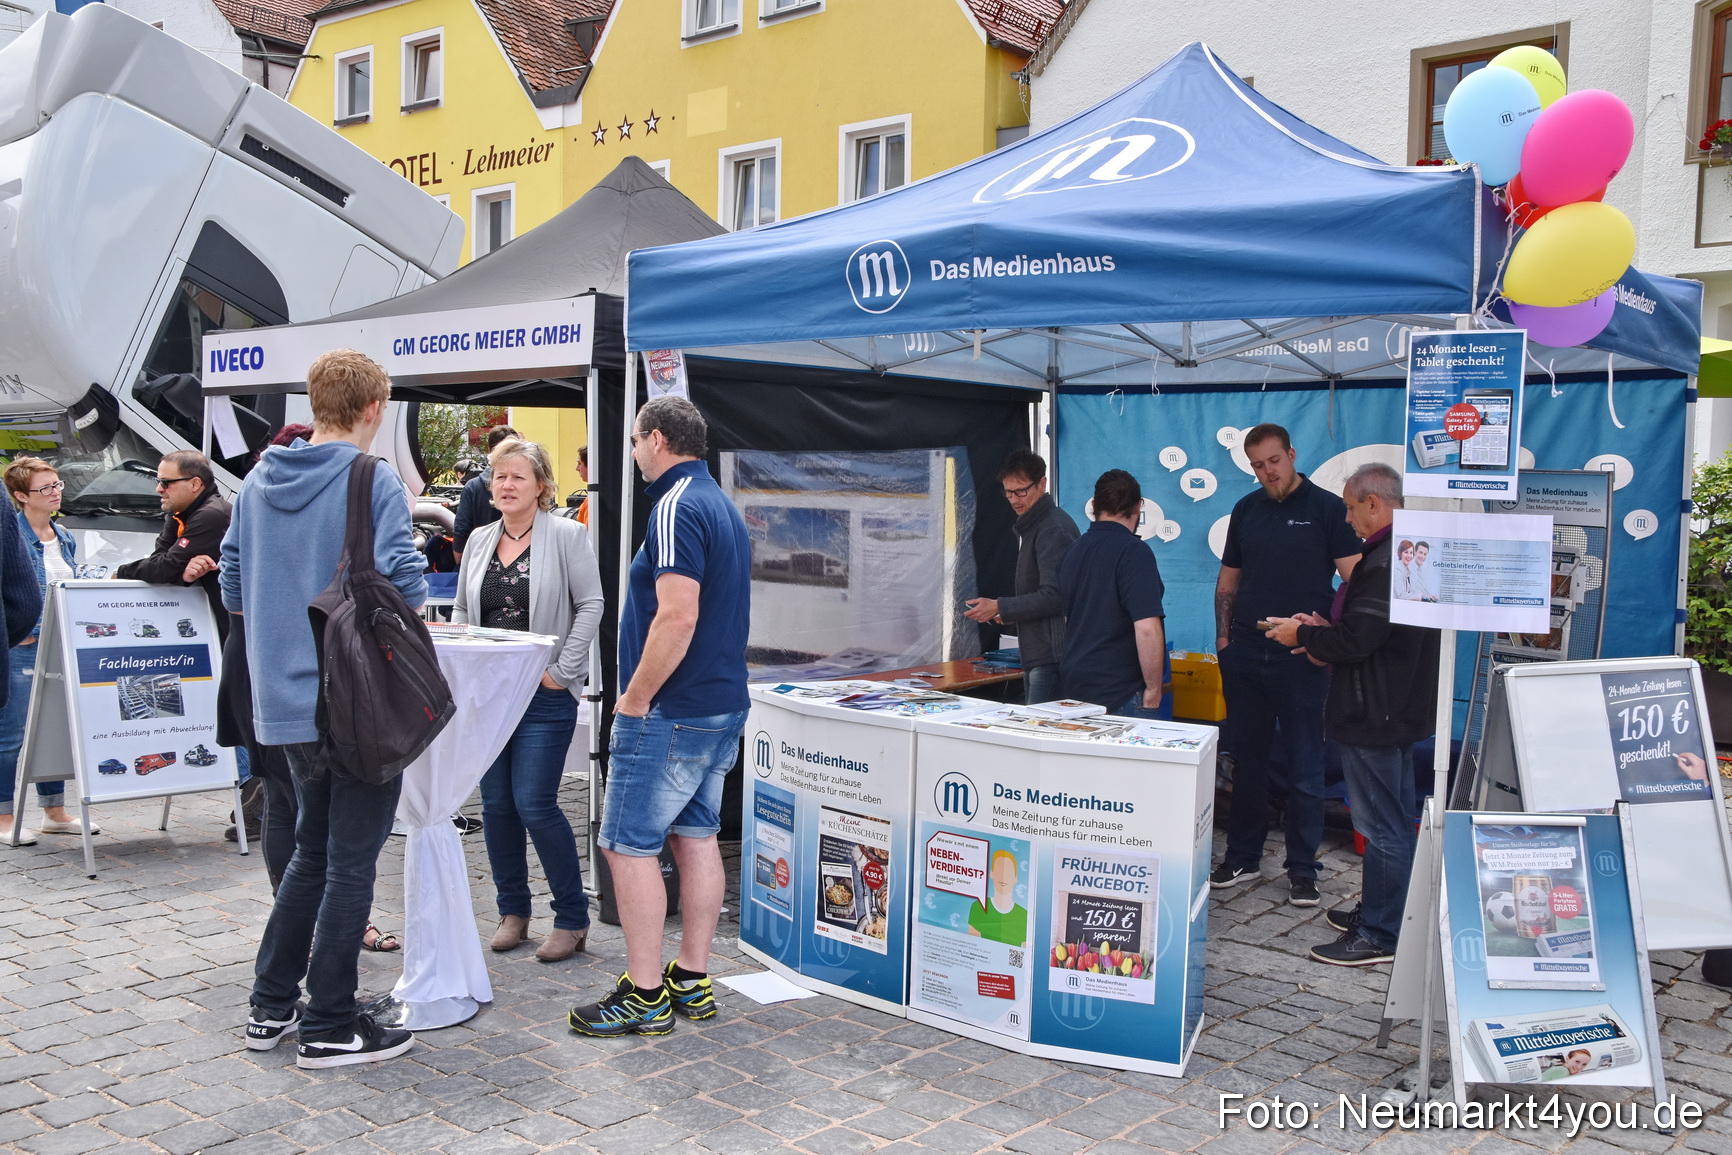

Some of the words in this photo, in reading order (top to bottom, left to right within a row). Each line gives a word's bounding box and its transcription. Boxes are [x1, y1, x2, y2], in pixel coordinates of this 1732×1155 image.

[382, 151, 442, 187] OTEL
[462, 137, 555, 176] Lehmeier
[930, 259, 970, 281] Das
[972, 253, 1116, 278] Medienhaus
[1618, 283, 1657, 315] Medienhaus
[393, 337, 416, 357] GM
[420, 333, 471, 355] GEORG
[475, 328, 527, 350] MEIER
[531, 323, 582, 346] GMBH
[1416, 346, 1427, 355] 24
[1429, 344, 1467, 354] Monate
[1469, 343, 1497, 353] lesen
[210, 346, 264, 373] IVECO
[1415, 357, 1444, 367] Tablet
[1446, 356, 1505, 369] geschenkt!
[1448, 423, 1475, 432] gratis
[1526, 487, 1540, 495] Das
[1542, 488, 1588, 497] Medienhaus
[1433, 561, 1485, 570] Gebietsleiter/in
[99, 654, 195, 671] Fachlagerist/in
[1642, 680, 1665, 693] Zeitung
[1666, 679, 1682, 689] lesen
[1618, 704, 1664, 741] 150
[1671, 700, 1690, 734] €
[92, 732, 108, 740] eine
[111, 729, 150, 739] Ausbildung
[781, 741, 796, 758] Das
[797, 747, 869, 774] Medienhaus
[1620, 740, 1671, 769] geschenkt!
[781, 761, 795, 774] Meine
[795, 766, 818, 782] Zeitung
[819, 773, 830, 784] für
[831, 775, 862, 789] zuhause
[780, 772, 789, 783] Das
[789, 774, 826, 794] Medienhaus
[827, 784, 838, 796] für
[839, 789, 857, 800] mein
[859, 792, 882, 805] Leben
[1635, 782, 1702, 794] Mittelbayerische
[993, 783, 1022, 801] Das
[1026, 788, 1134, 814] Medienhaus
[757, 803, 791, 826] Lesegutschein
[839, 815, 861, 826] Meine
[992, 806, 1020, 818] Meine
[1022, 810, 1059, 826] Zeitung
[1061, 815, 1076, 827] für
[1079, 817, 1123, 831] zuhause
[828, 821, 889, 843] KÜCHENSCHÄTZE
[992, 819, 1009, 830] Das
[1011, 822, 1070, 840] Medienhaus
[1072, 830, 1088, 841] für
[1090, 834, 1117, 843] mein
[1120, 834, 1152, 848] Leben
[1510, 841, 1539, 849] Steilvorlage
[930, 847, 965, 862] NEBEN-
[1485, 852, 1500, 861] Jetzt
[1532, 851, 1558, 860] Zeitung
[930, 859, 984, 879] VERDIENST?
[1061, 856, 1153, 878] FRÜHLINGS-
[1490, 860, 1523, 868] WM-Preis
[1070, 874, 1150, 894] ANGEBOT:
[1081, 899, 1101, 908] Monate
[1102, 901, 1123, 911] Zeitung
[1521, 900, 1547, 908] Bischofshof
[1554, 904, 1578, 912] GRATIS
[1082, 909, 1117, 928] 150
[1121, 912, 1136, 929] €
[1092, 930, 1131, 943] sparen!
[1096, 978, 1128, 987] Medienhaus
[248, 1026, 268, 1035] NIKE
[1514, 1026, 1613, 1051] Mittelbayerische
